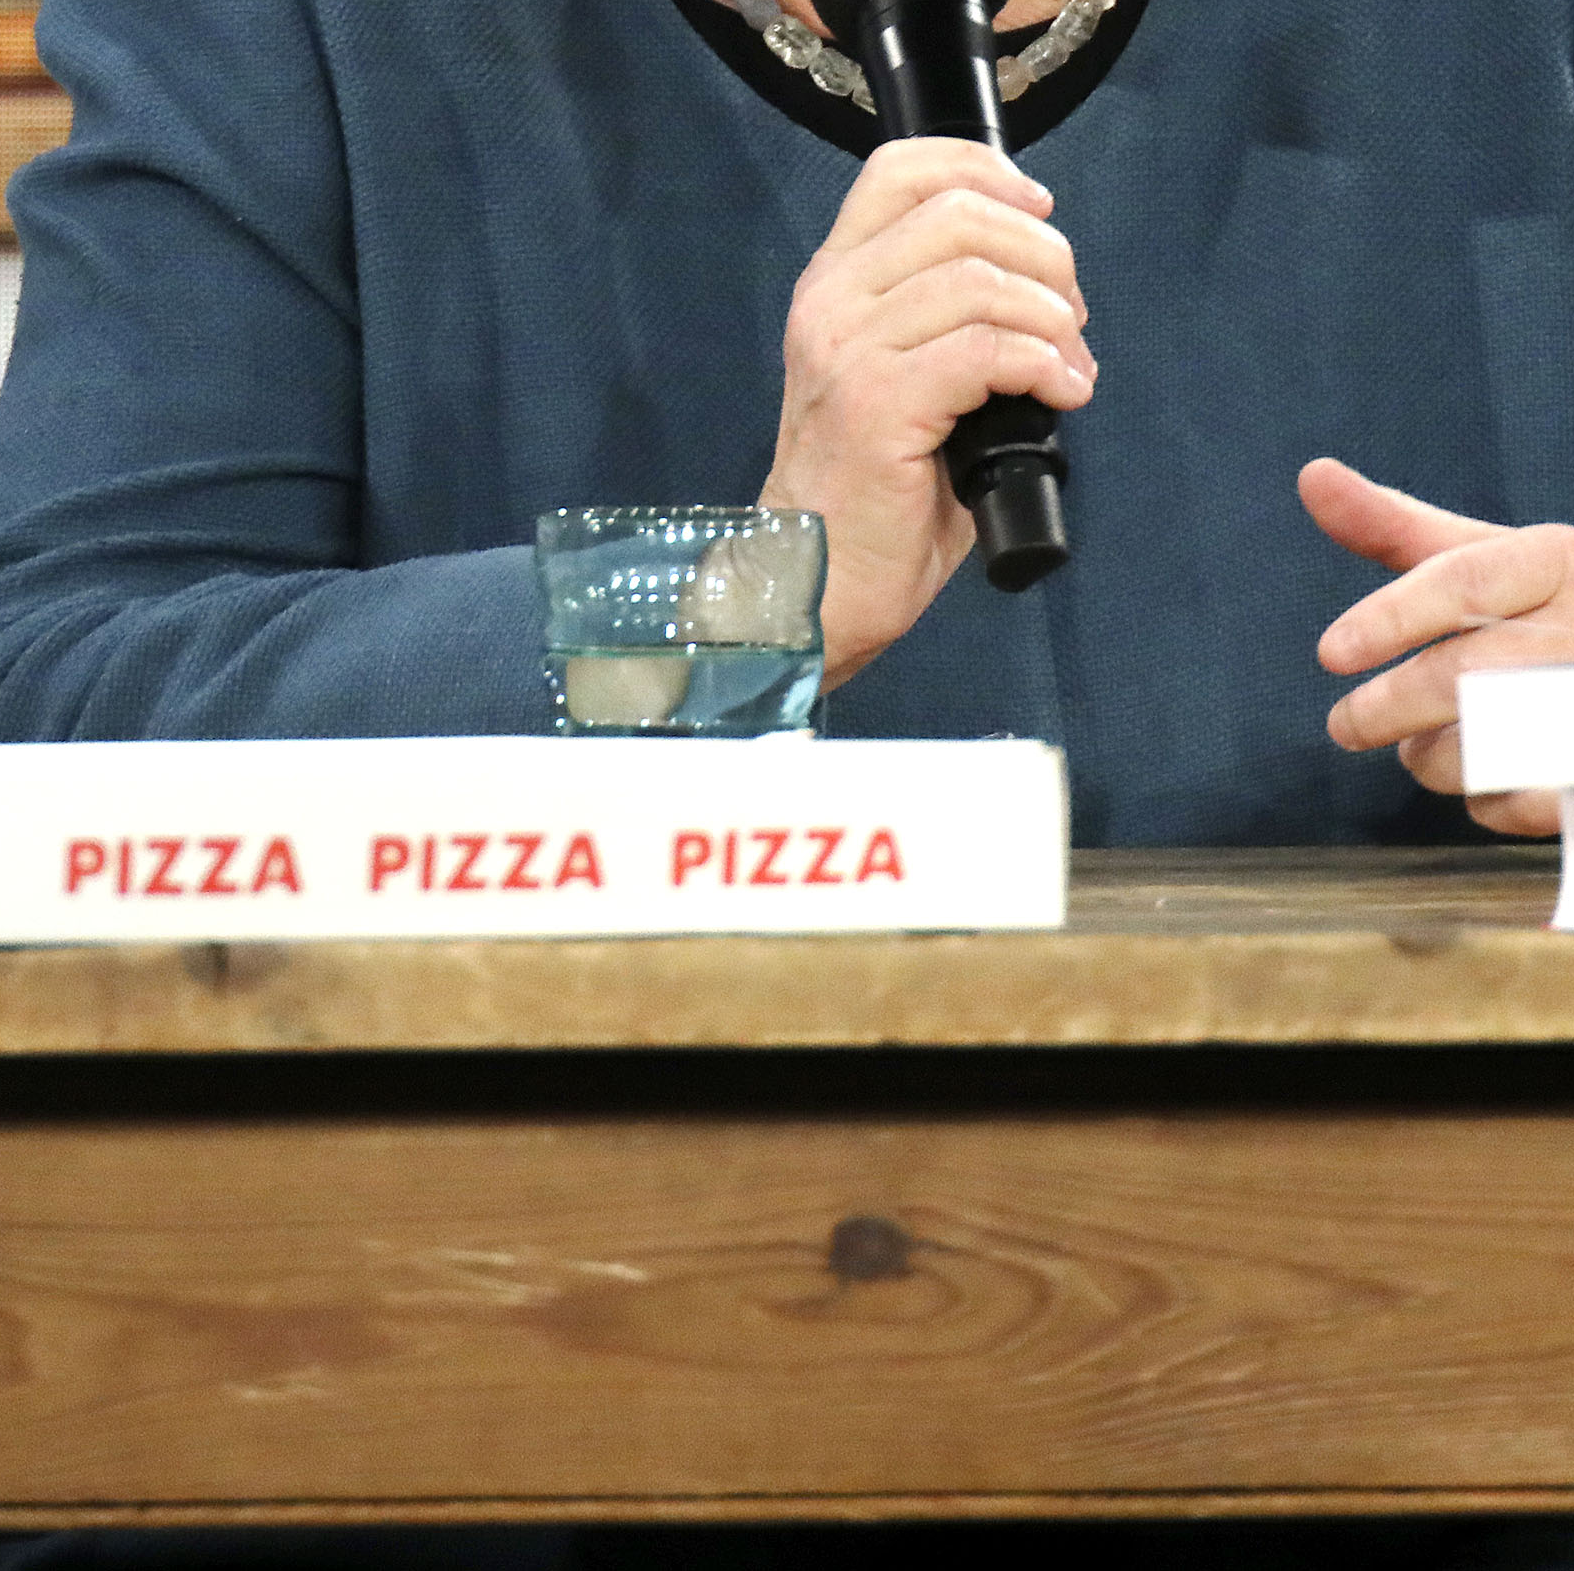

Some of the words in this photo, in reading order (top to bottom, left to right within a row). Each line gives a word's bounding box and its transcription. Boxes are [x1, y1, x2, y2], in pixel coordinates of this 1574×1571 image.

[66, 838, 301, 897] PIZZA
[369, 833, 603, 893] PIZZA
[671, 828, 904, 887] PIZZA
